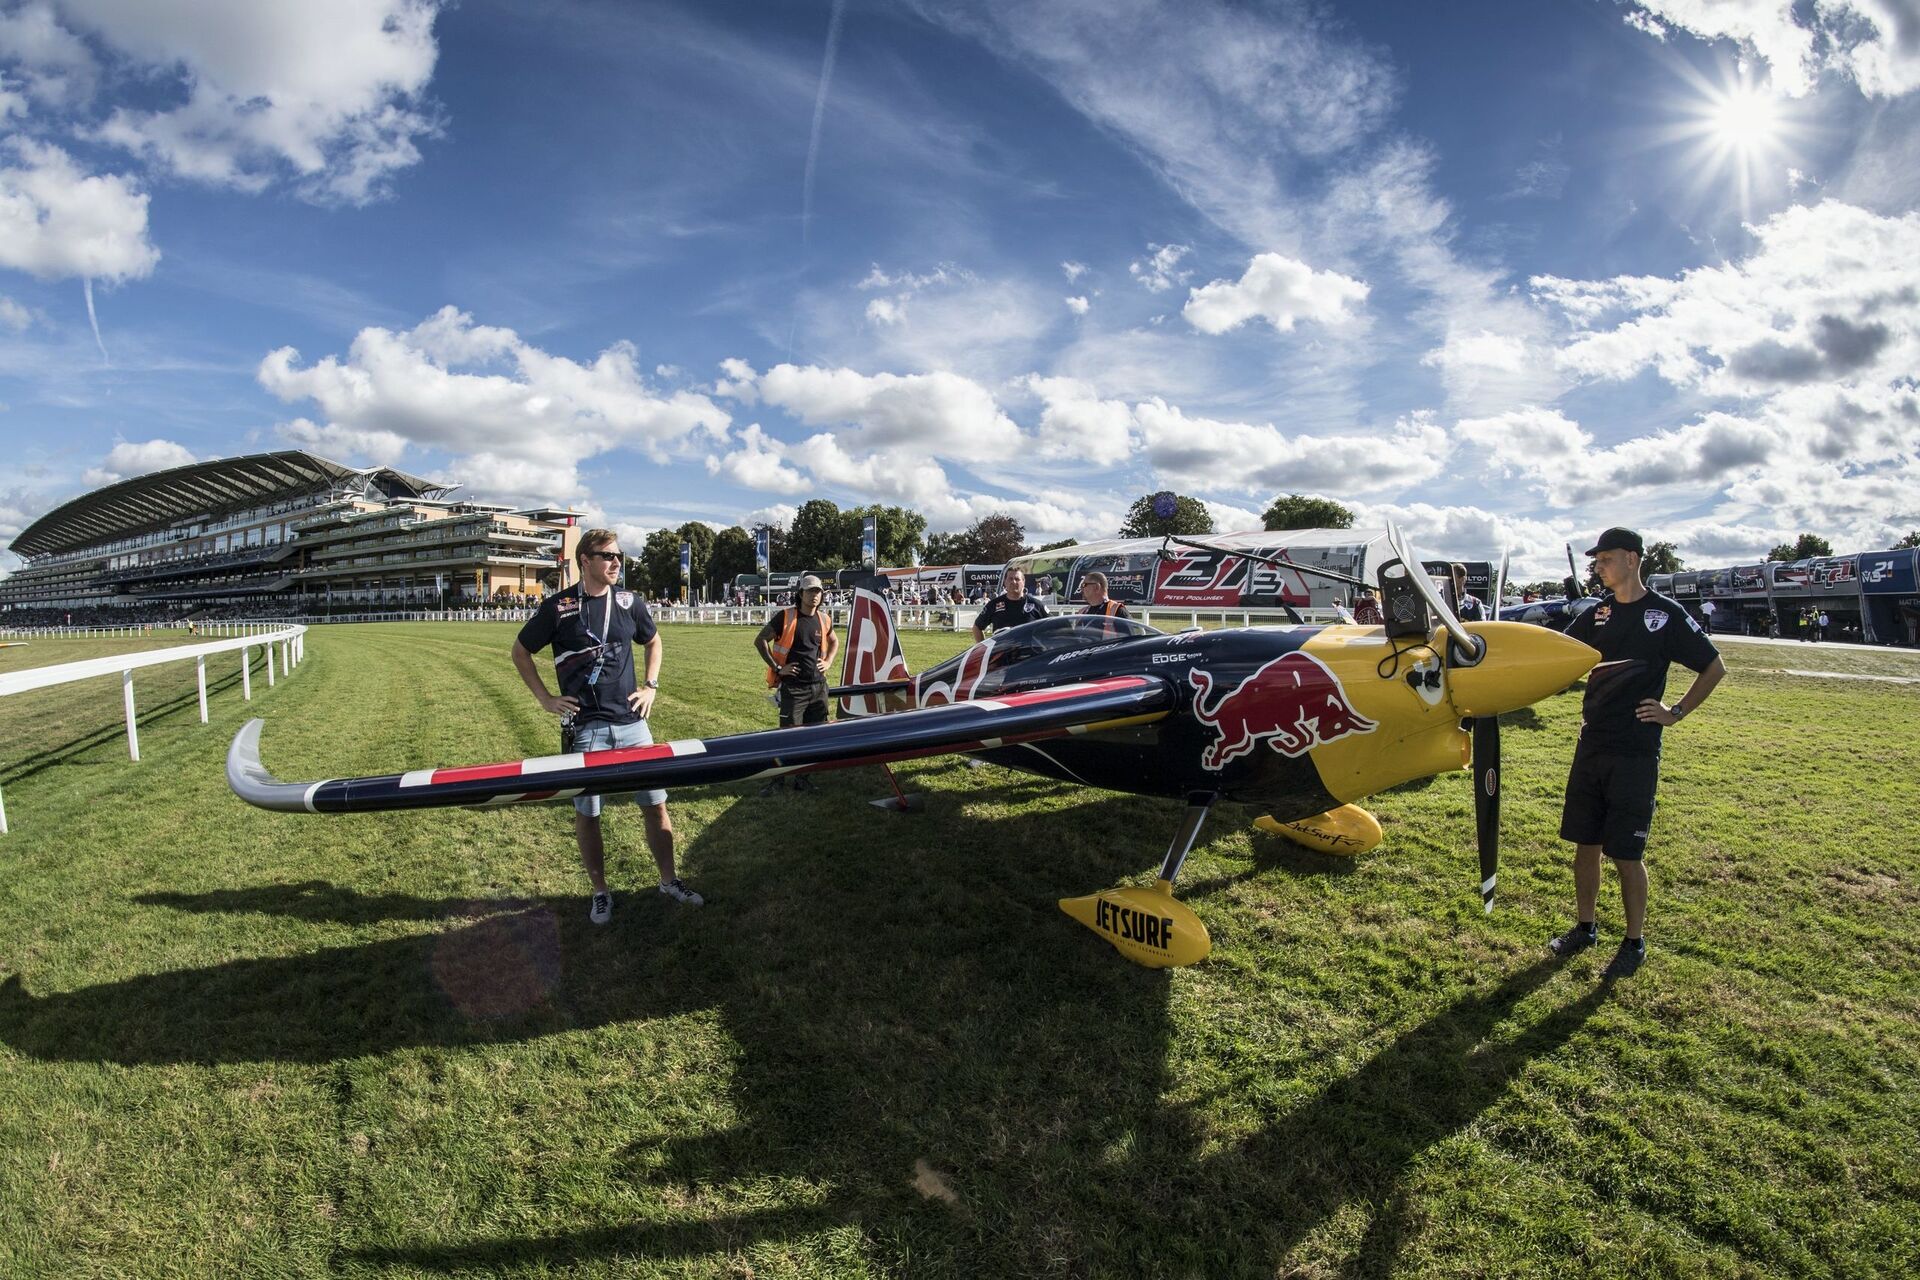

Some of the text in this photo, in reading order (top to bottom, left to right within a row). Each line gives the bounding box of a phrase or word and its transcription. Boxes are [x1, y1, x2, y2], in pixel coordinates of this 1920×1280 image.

[1875, 560, 1894, 578] 21
[938, 571, 958, 582] 26
[1755, 578, 1764, 589] 10
[1152, 653, 1187, 664] EDGE
[1096, 897, 1173, 950] JETSURF
